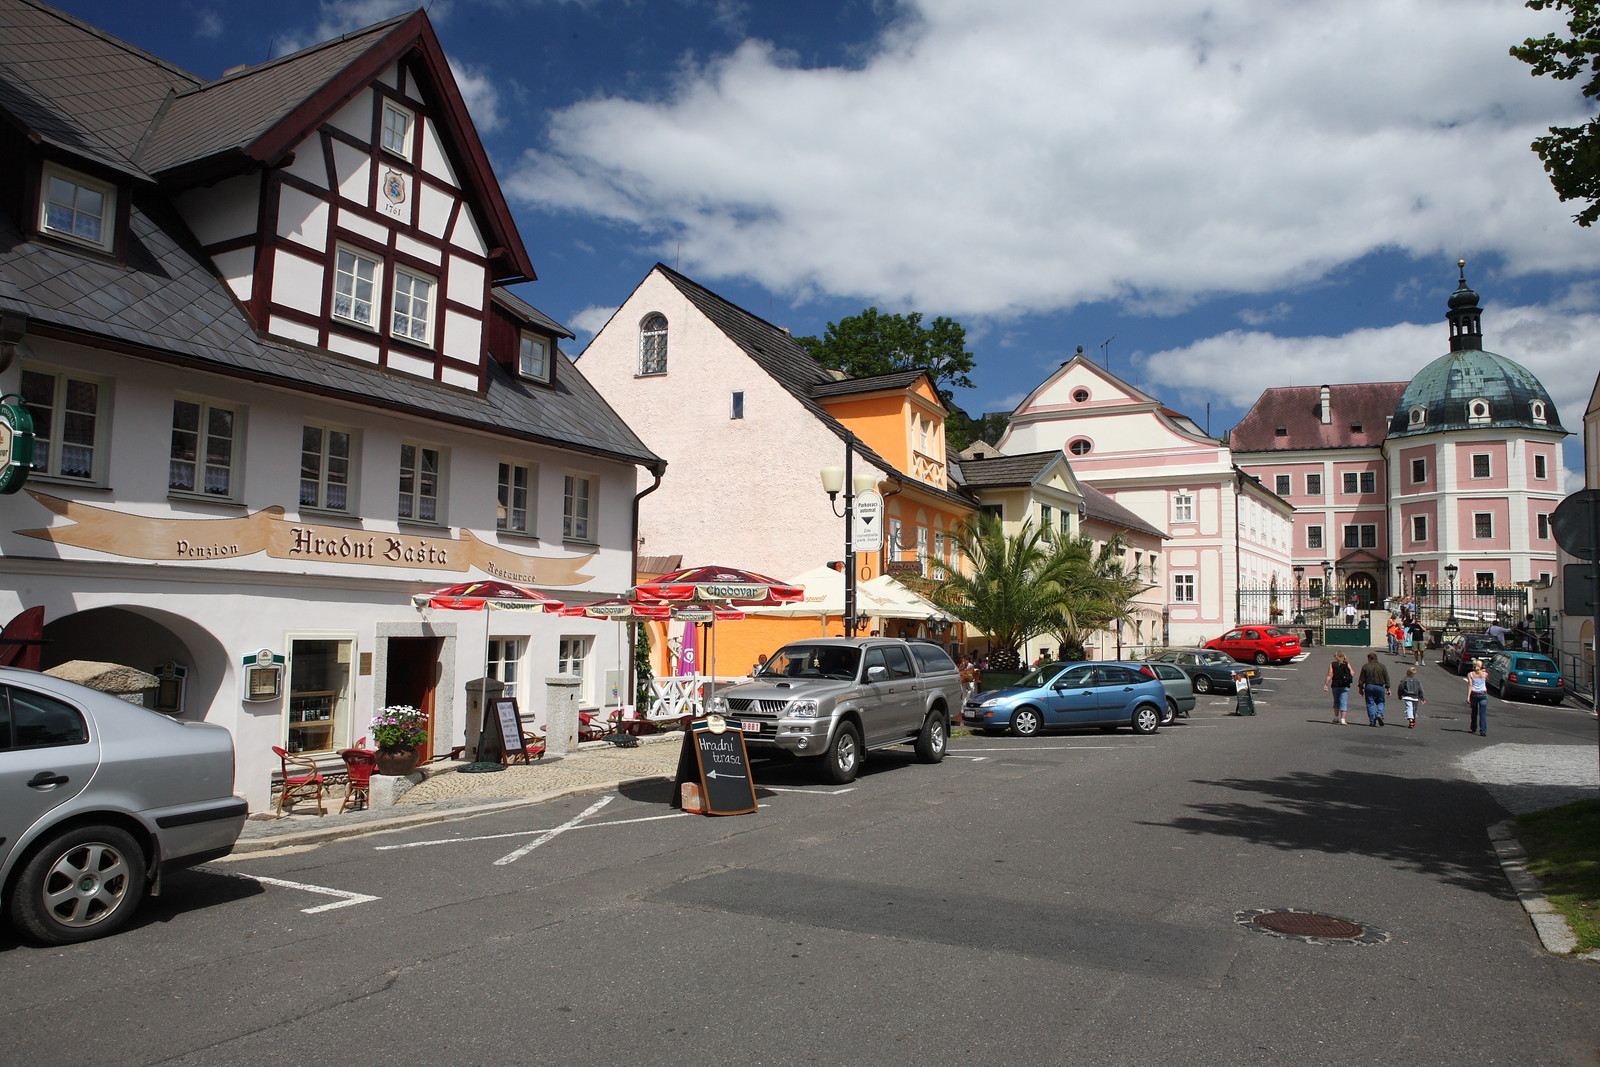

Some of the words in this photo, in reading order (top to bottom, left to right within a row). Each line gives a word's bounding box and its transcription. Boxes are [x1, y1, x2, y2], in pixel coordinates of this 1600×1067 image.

[385, 203, 401, 216] 1761
[176, 540, 239, 560] Penzion
[289, 527, 375, 560] Hradní
[382, 537, 447, 565] Bašta
[487, 561, 536, 583] Restaurace
[706, 585, 758, 598] Chodovar
[698, 736, 734, 752] Hradní
[713, 751, 741, 764] terasa
